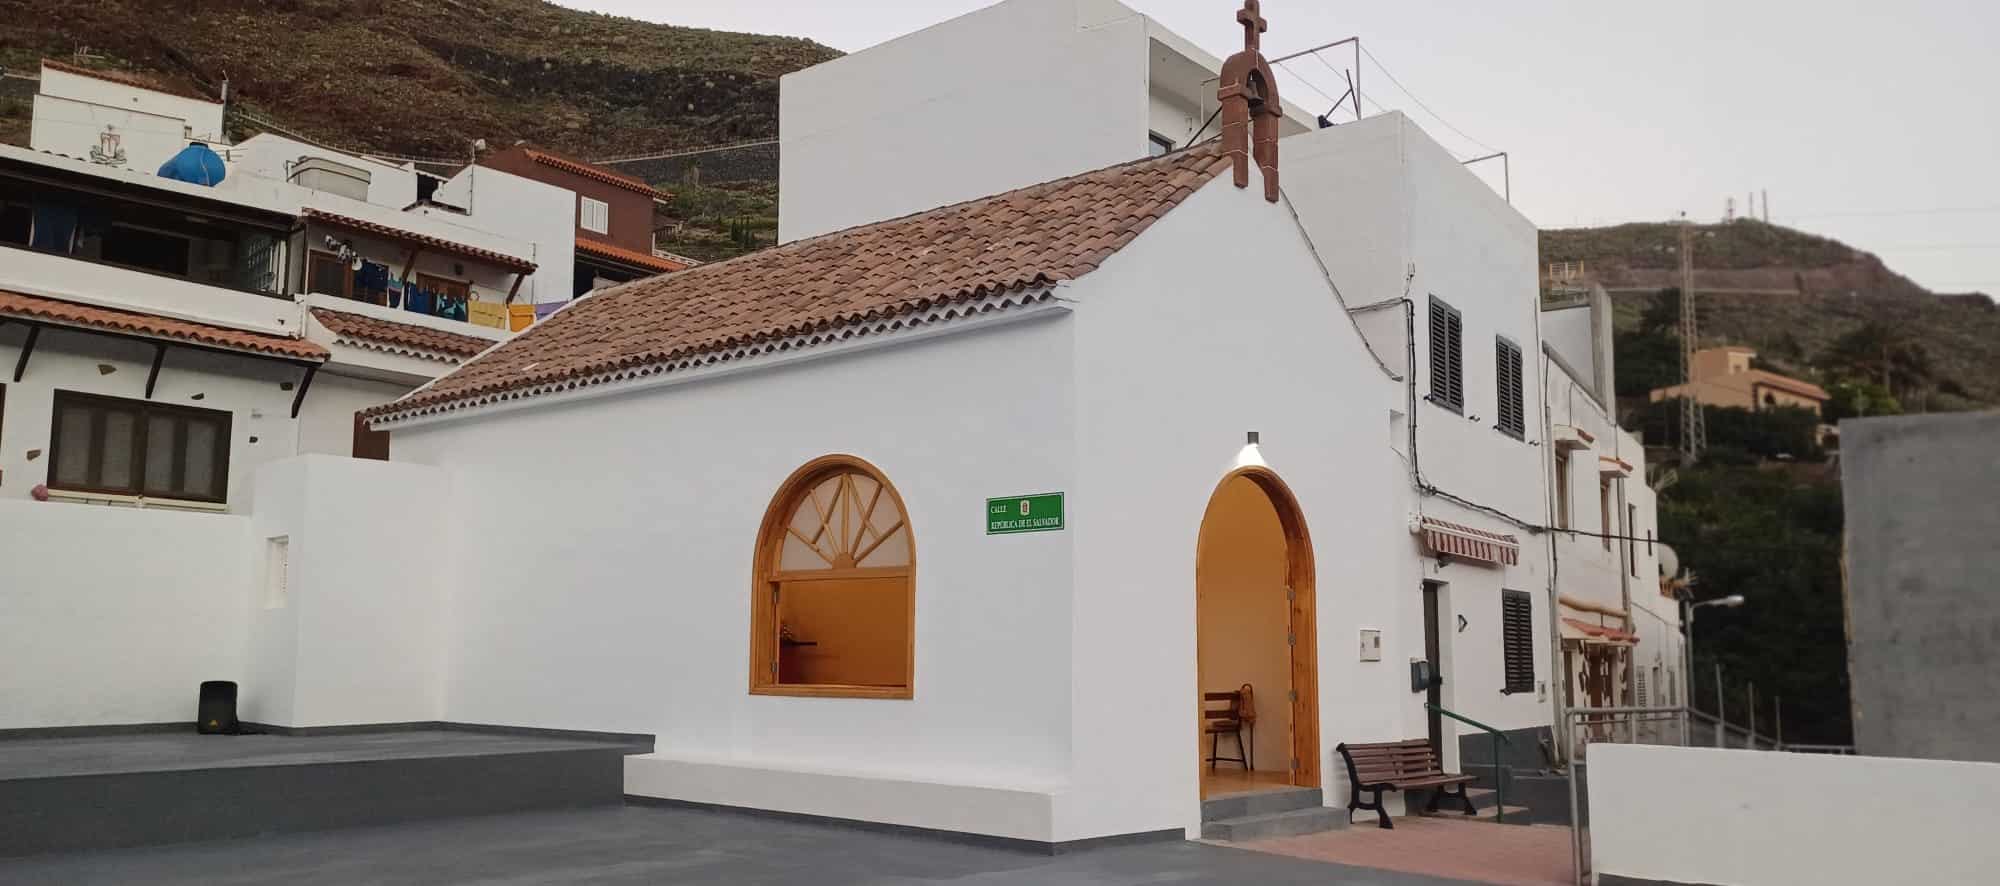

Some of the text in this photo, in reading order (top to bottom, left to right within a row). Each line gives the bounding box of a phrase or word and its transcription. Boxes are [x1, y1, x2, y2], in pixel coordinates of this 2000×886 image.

[991, 504, 1007, 513] CALLE
[1018, 519, 1025, 528] DE
[1026, 519, 1032, 527] EL
[1033, 517, 1059, 527] SALVADOR
